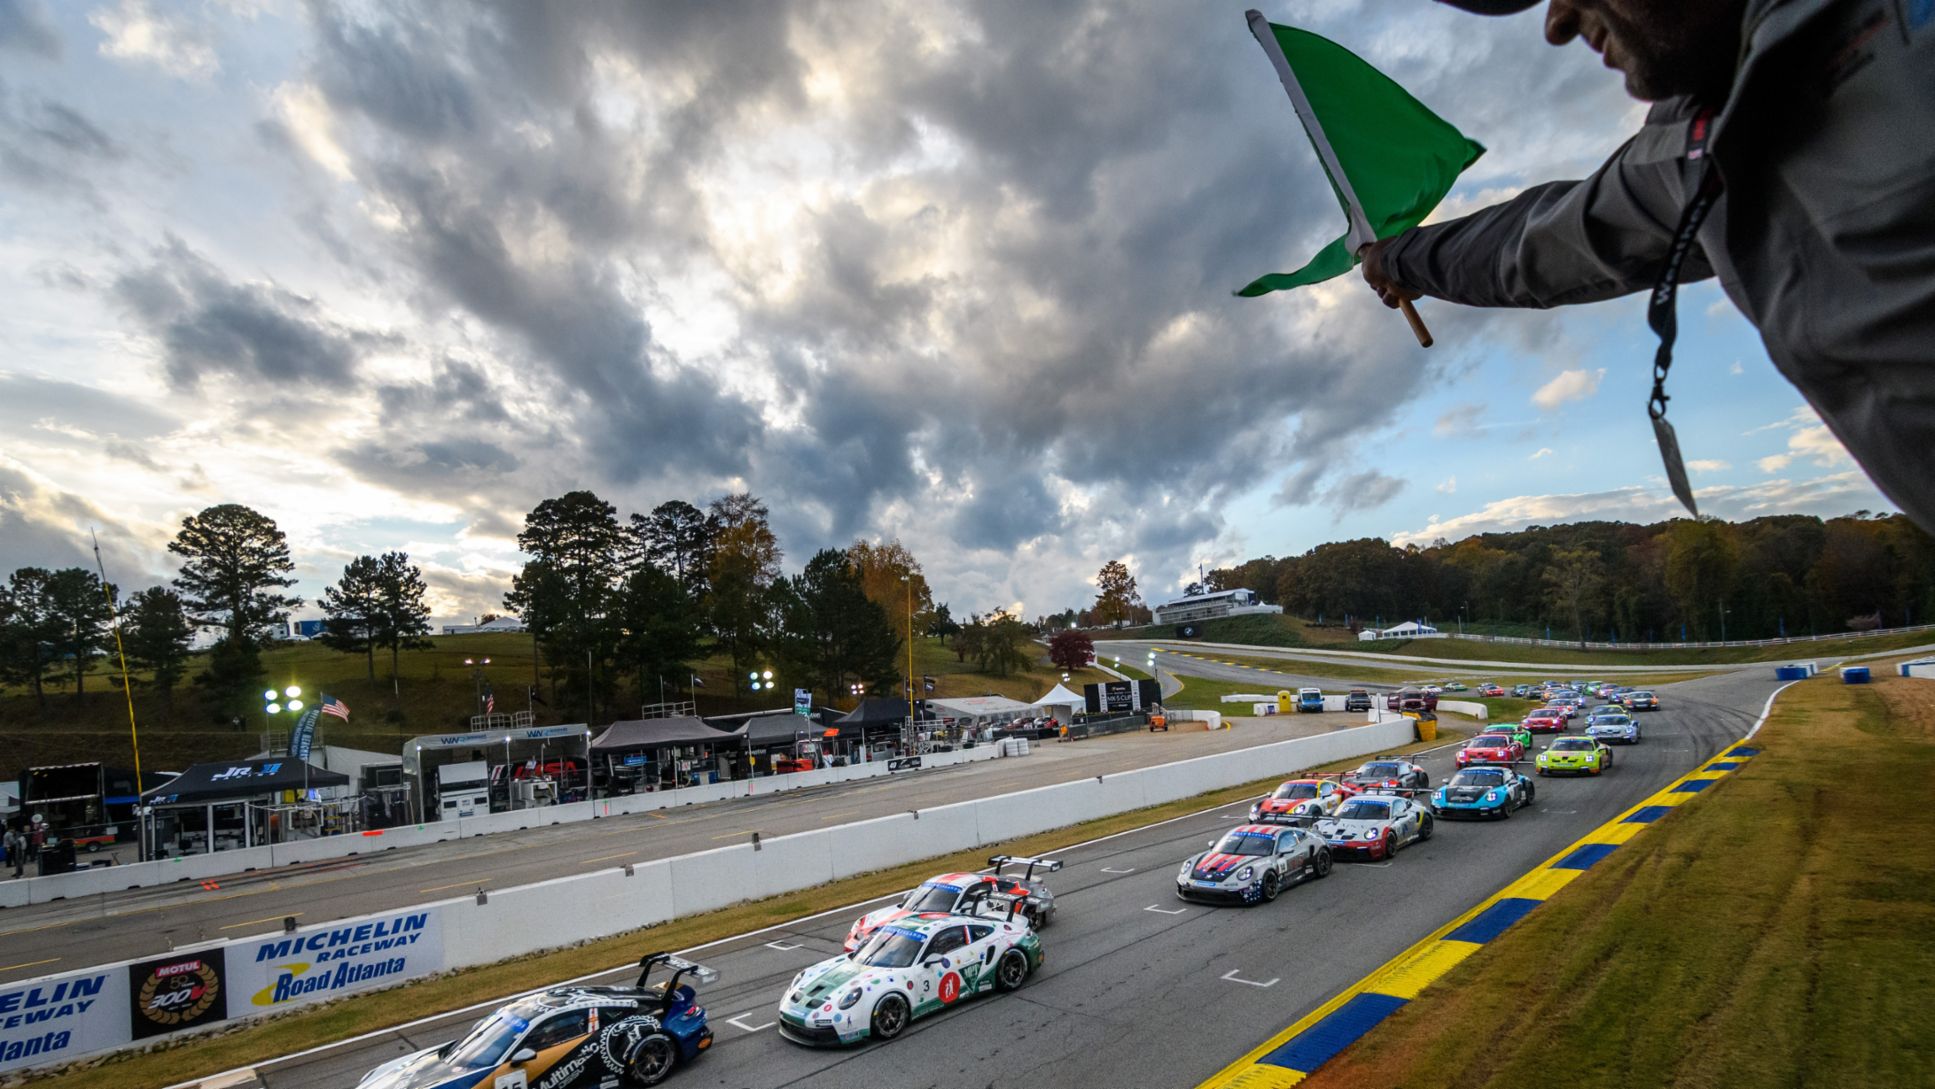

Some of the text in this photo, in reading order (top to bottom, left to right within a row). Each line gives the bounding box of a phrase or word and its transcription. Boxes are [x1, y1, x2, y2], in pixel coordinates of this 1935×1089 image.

[256, 912, 427, 962] MICHELIN
[316, 932, 421, 963] RACEWAY
[158, 962, 200, 976] MOTUL
[273, 957, 406, 1003] Road Atlanta
[148, 983, 209, 1009] 300V
[923, 980, 930, 992] 3
